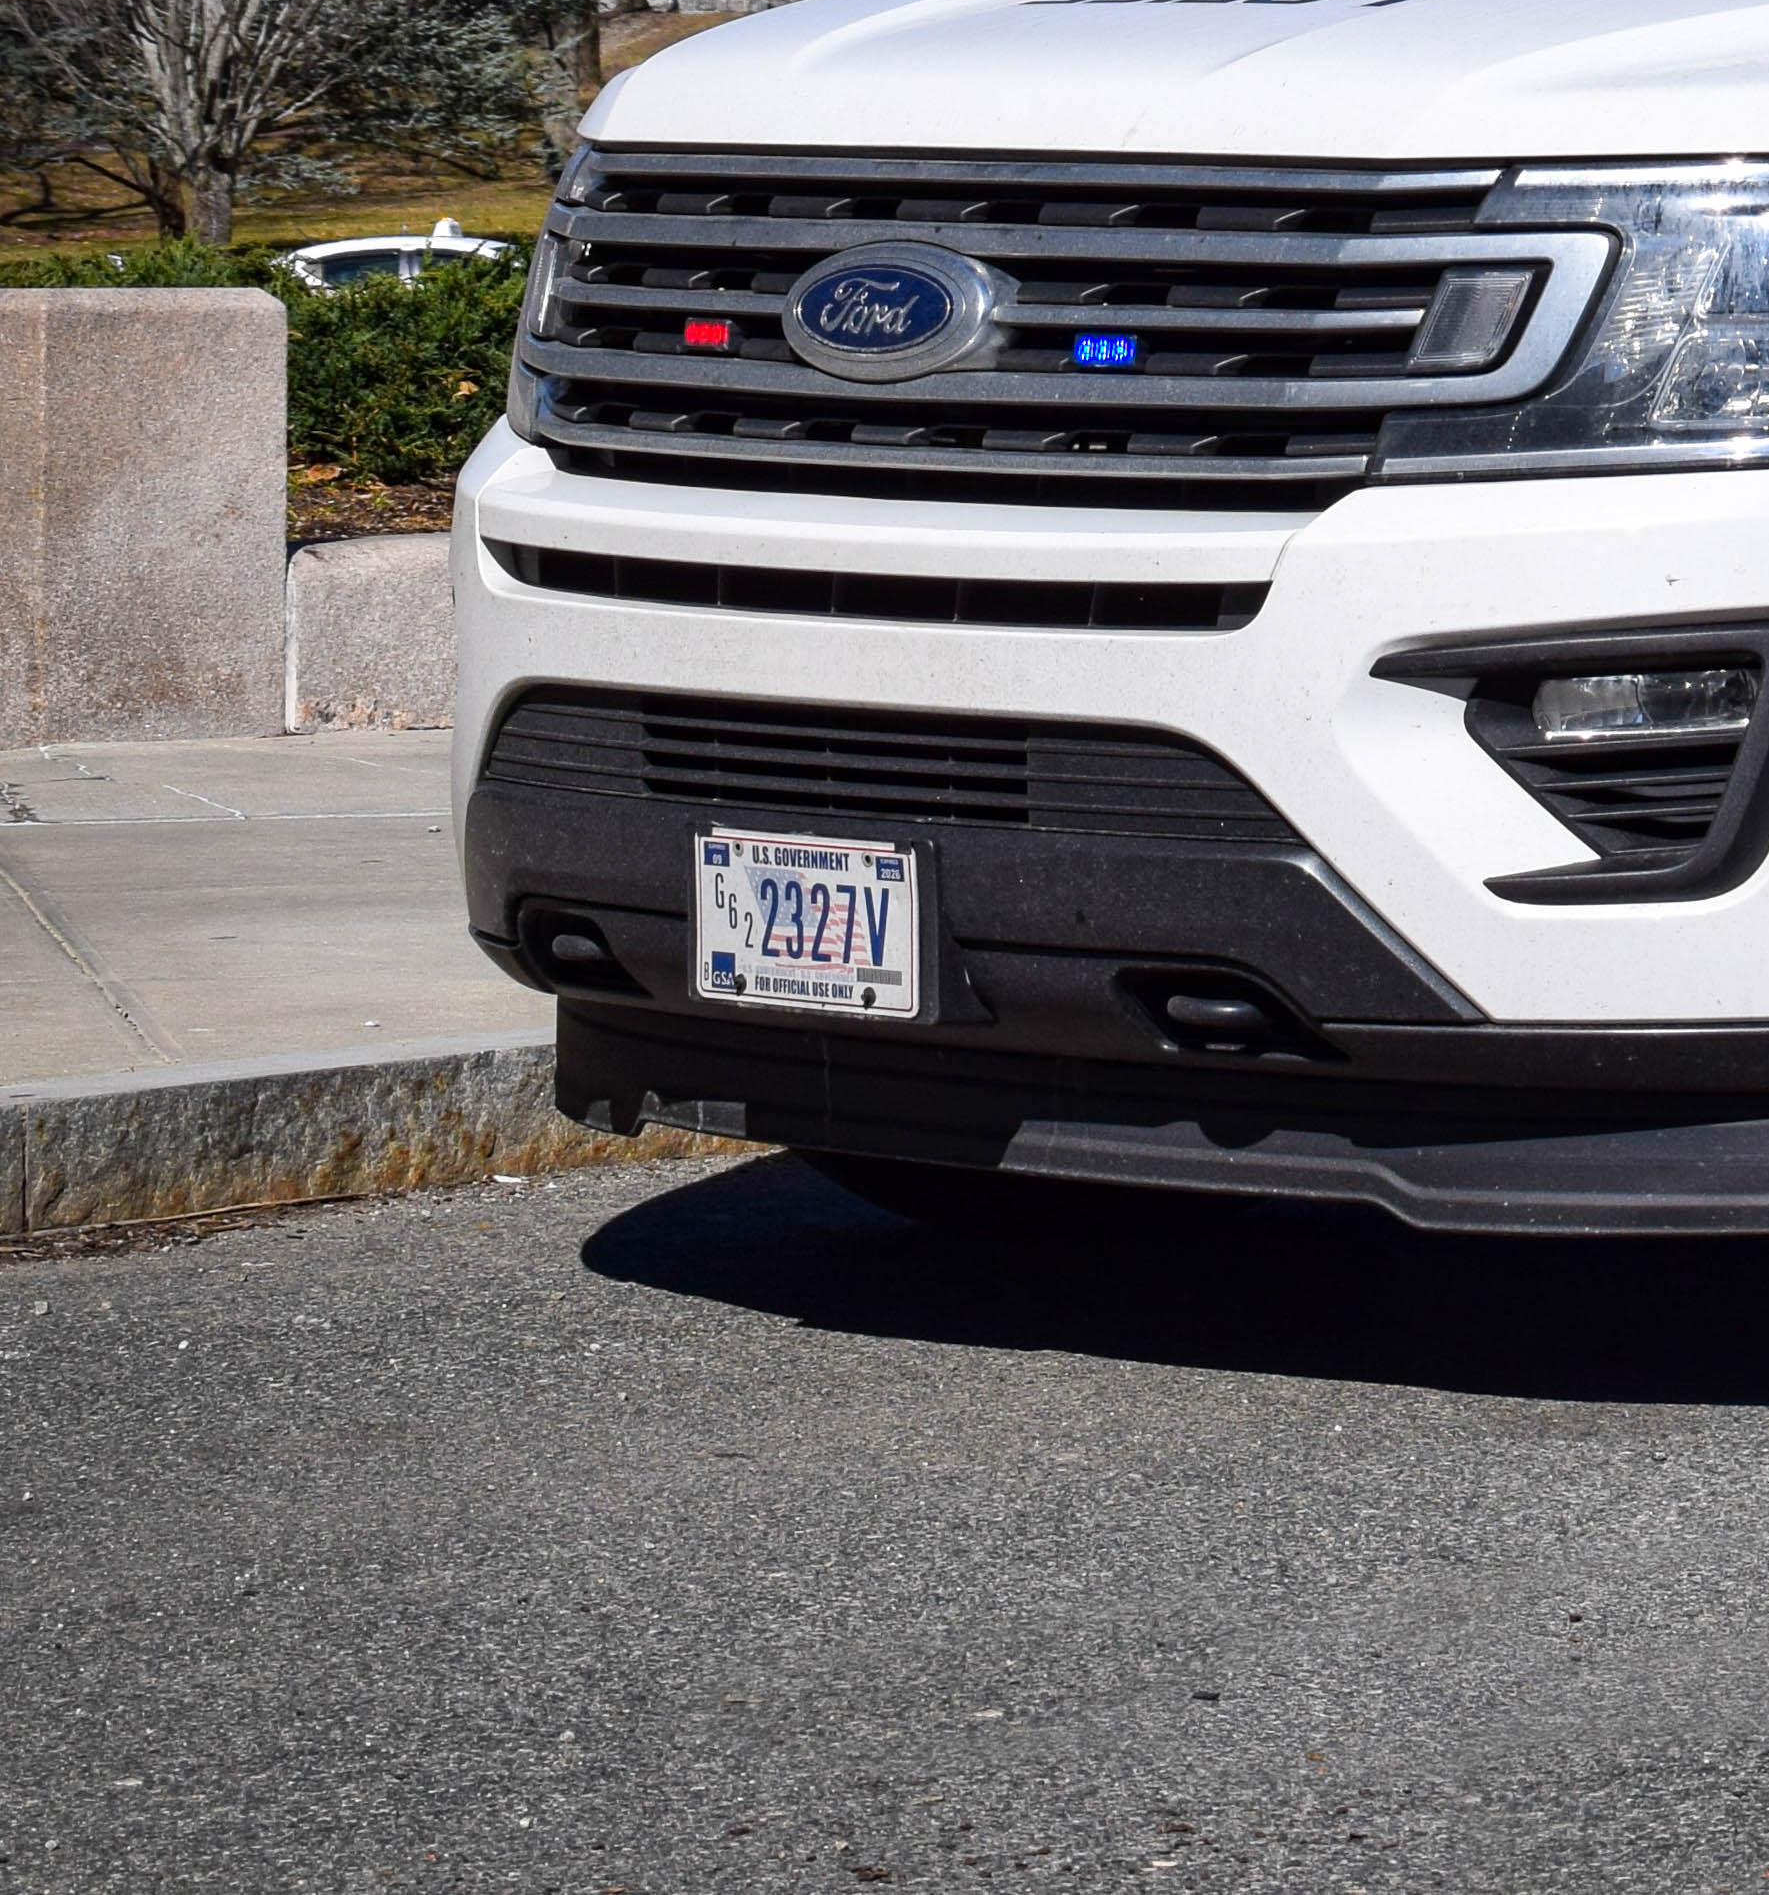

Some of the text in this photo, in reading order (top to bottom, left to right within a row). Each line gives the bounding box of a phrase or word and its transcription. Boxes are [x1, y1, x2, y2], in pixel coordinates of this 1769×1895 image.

[819, 276, 920, 338] Ford
[752, 844, 850, 872] U.S. GOVERNMENT
[760, 877, 890, 967] 2327V
[712, 970, 735, 986] GSA
[754, 975, 854, 1000] FOR OFFICIAL USE ONLY
